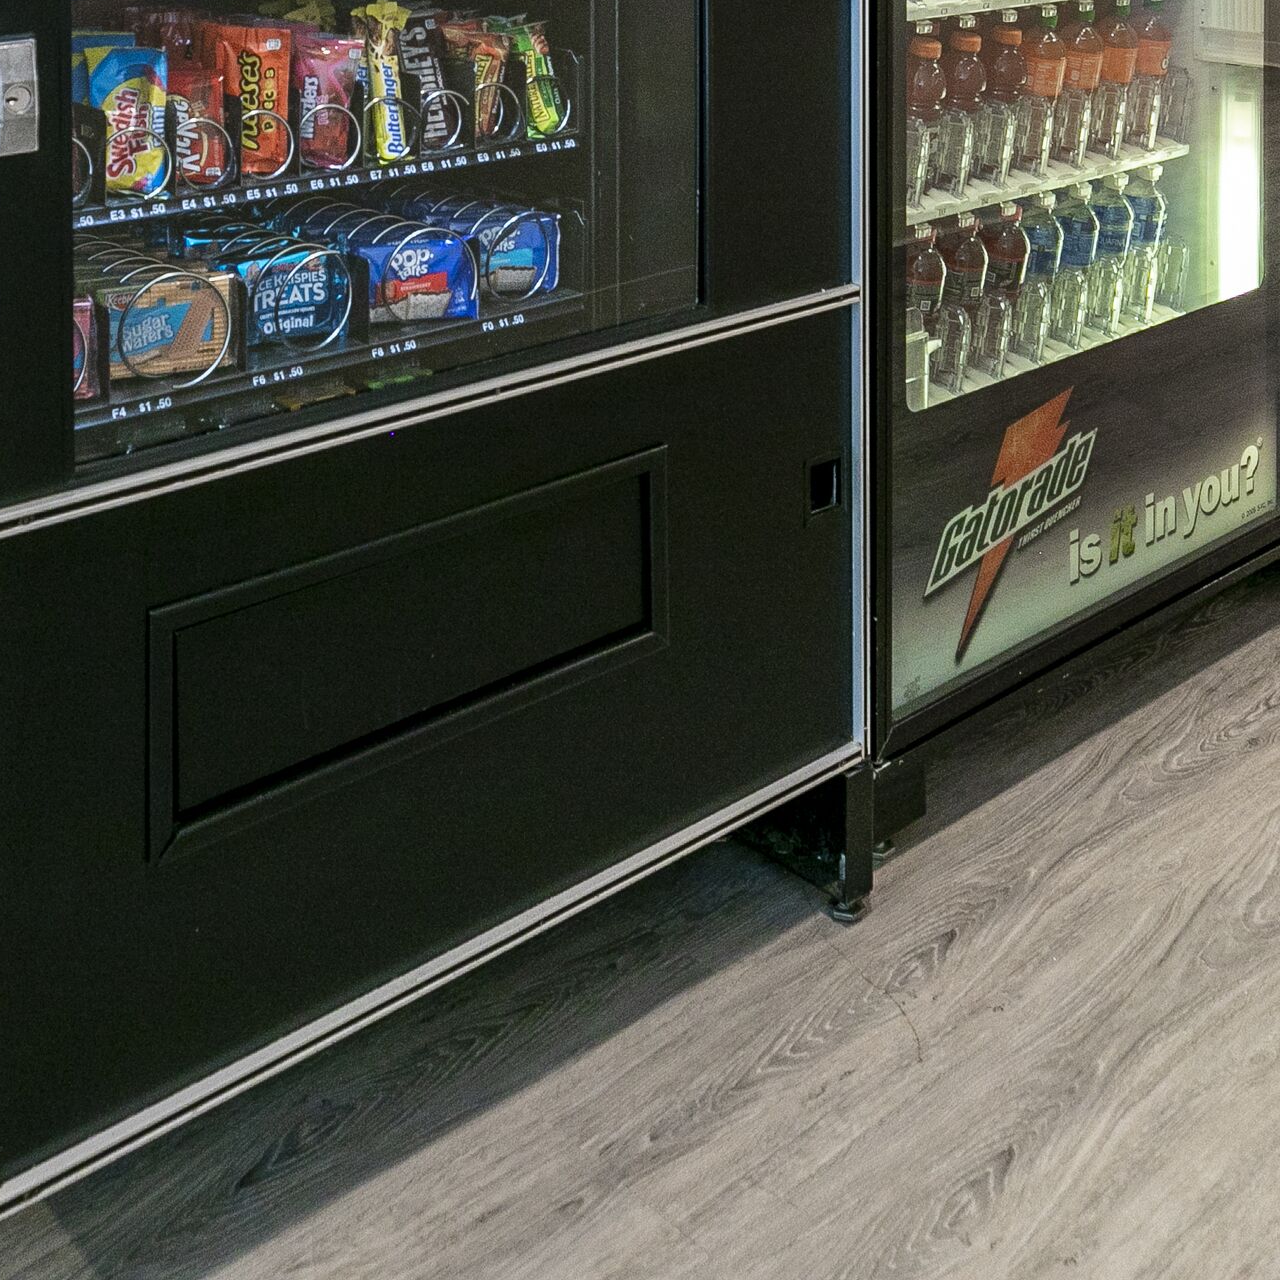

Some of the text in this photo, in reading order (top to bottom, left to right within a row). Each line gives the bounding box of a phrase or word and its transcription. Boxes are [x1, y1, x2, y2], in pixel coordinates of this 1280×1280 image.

[381, 62, 407, 156] Butterfinger
[106, 87, 140, 180] Swedish
[128, 102, 152, 156] Fish
[109, 209, 126, 221] E3
[181, 198, 197, 210] E4
[121, 326, 174, 354] Wafers
[122, 313, 170, 341] Sugar
[252, 374, 266, 387] F6
[111, 406, 127, 420] F4
[926, 429, 1097, 594] Gatorade
[1070, 444, 1260, 584] is it in you?
